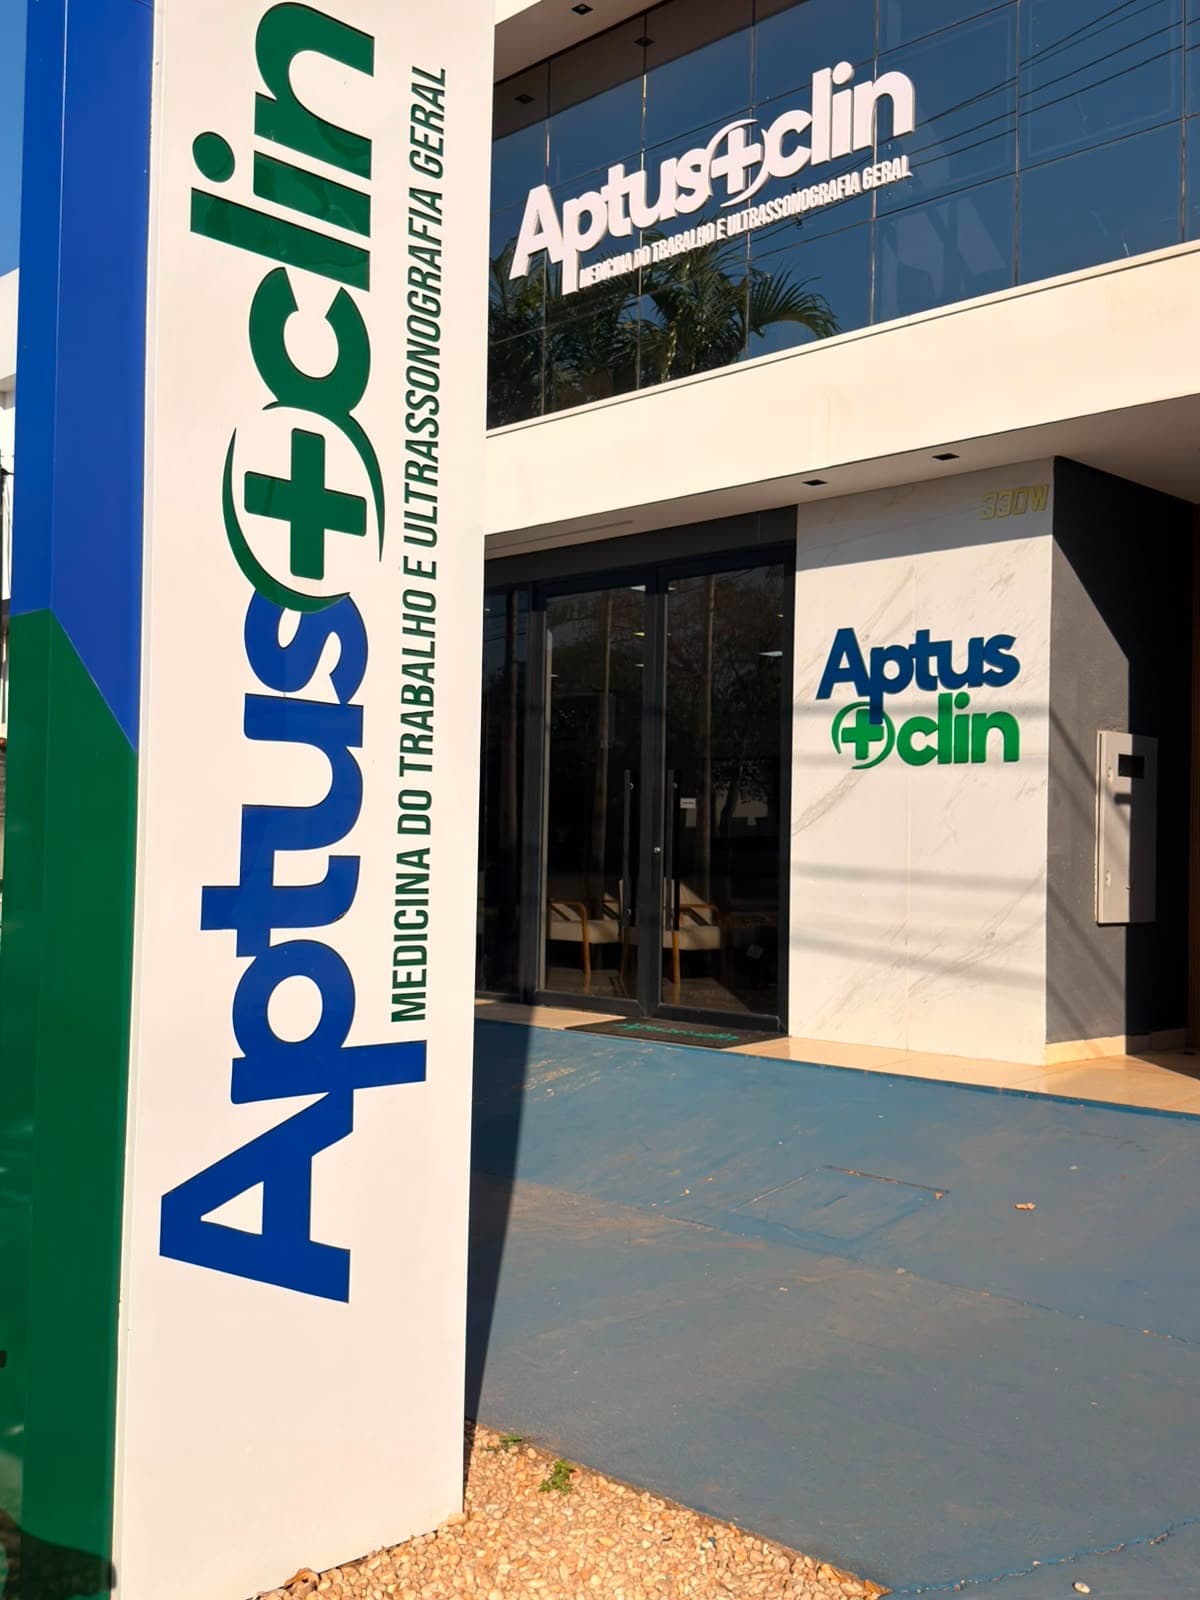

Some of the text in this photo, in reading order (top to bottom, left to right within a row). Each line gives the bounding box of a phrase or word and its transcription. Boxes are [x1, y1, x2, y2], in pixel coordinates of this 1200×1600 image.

[509, 60, 916, 296] Aptus clin
[579, 154, 914, 288] MEDICINA DO TRABALHO E ULTRASSONOGRAFIA GERAL
[391, 66, 446, 1022] MEDICINA DO TRABALHO E ULTRASSONOGRAFIA GERAL
[160, 1, 427, 1304] Aptus clin
[815, 627, 1021, 725] Aptus
[896, 691, 1020, 766] clin
